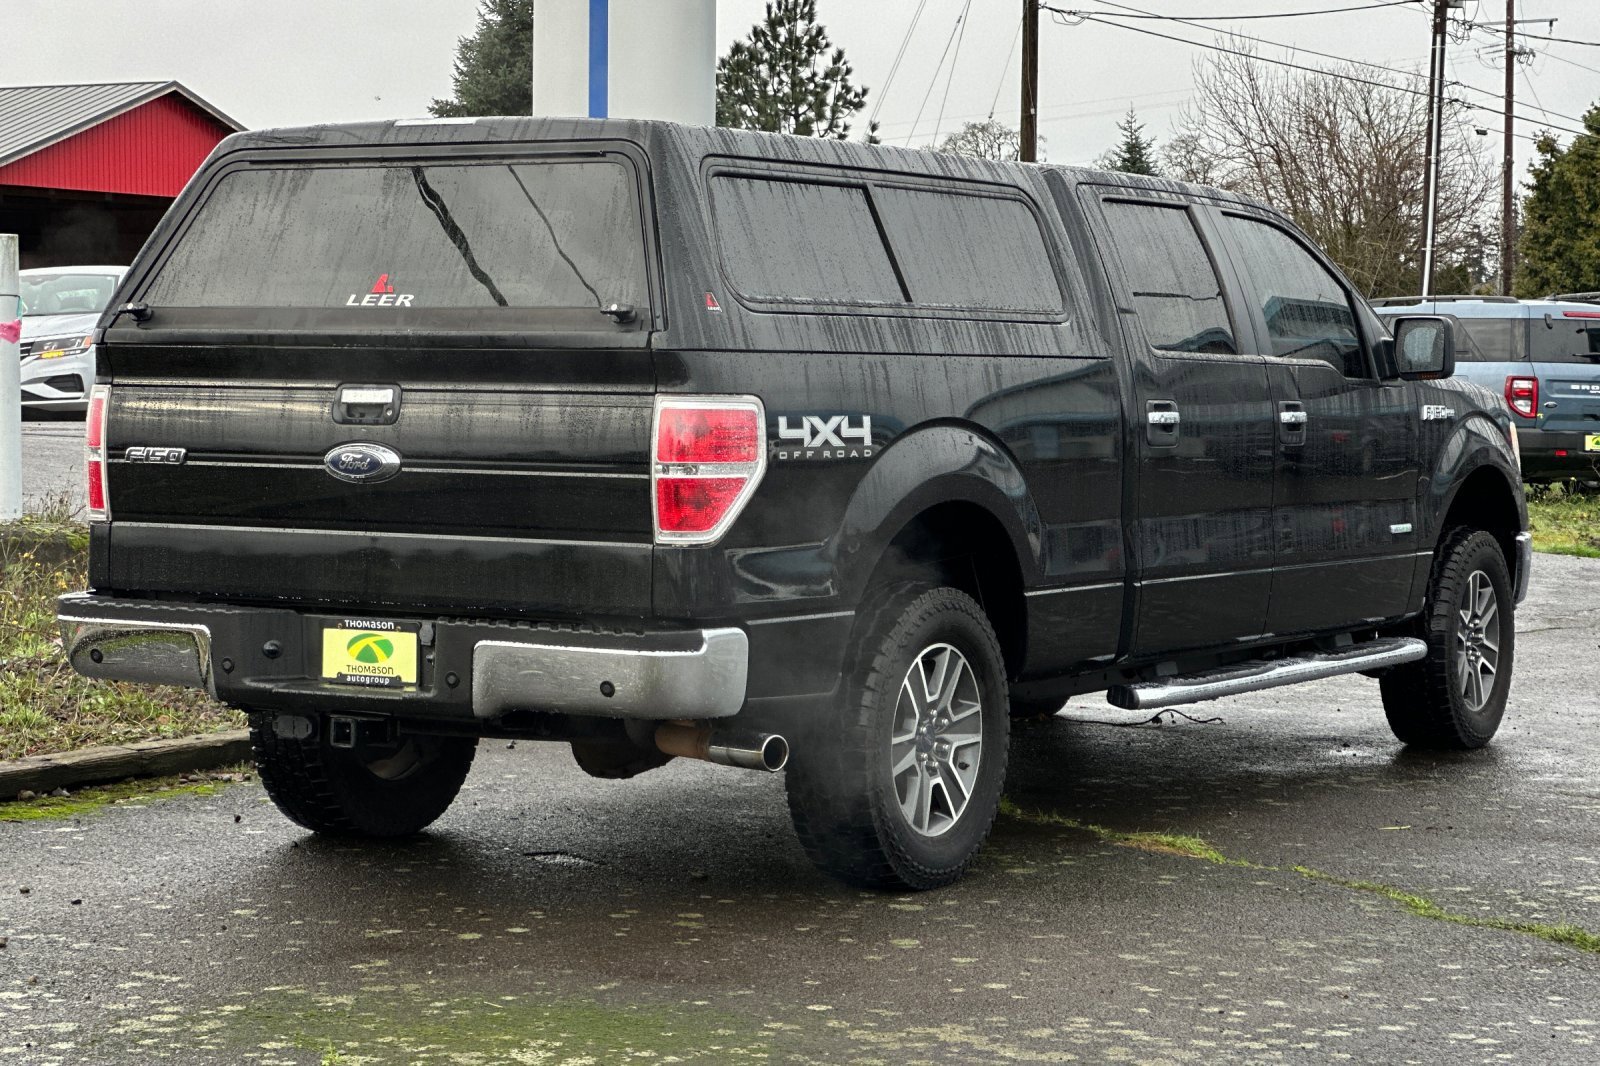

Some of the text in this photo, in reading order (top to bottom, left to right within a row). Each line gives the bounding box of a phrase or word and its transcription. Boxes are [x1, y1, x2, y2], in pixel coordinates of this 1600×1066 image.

[346, 294, 415, 307] LEER
[778, 415, 872, 448] 4X4
[338, 452, 371, 470] Ford
[779, 449, 872, 460] OFF ROAD
[346, 675, 390, 685] autogroup
